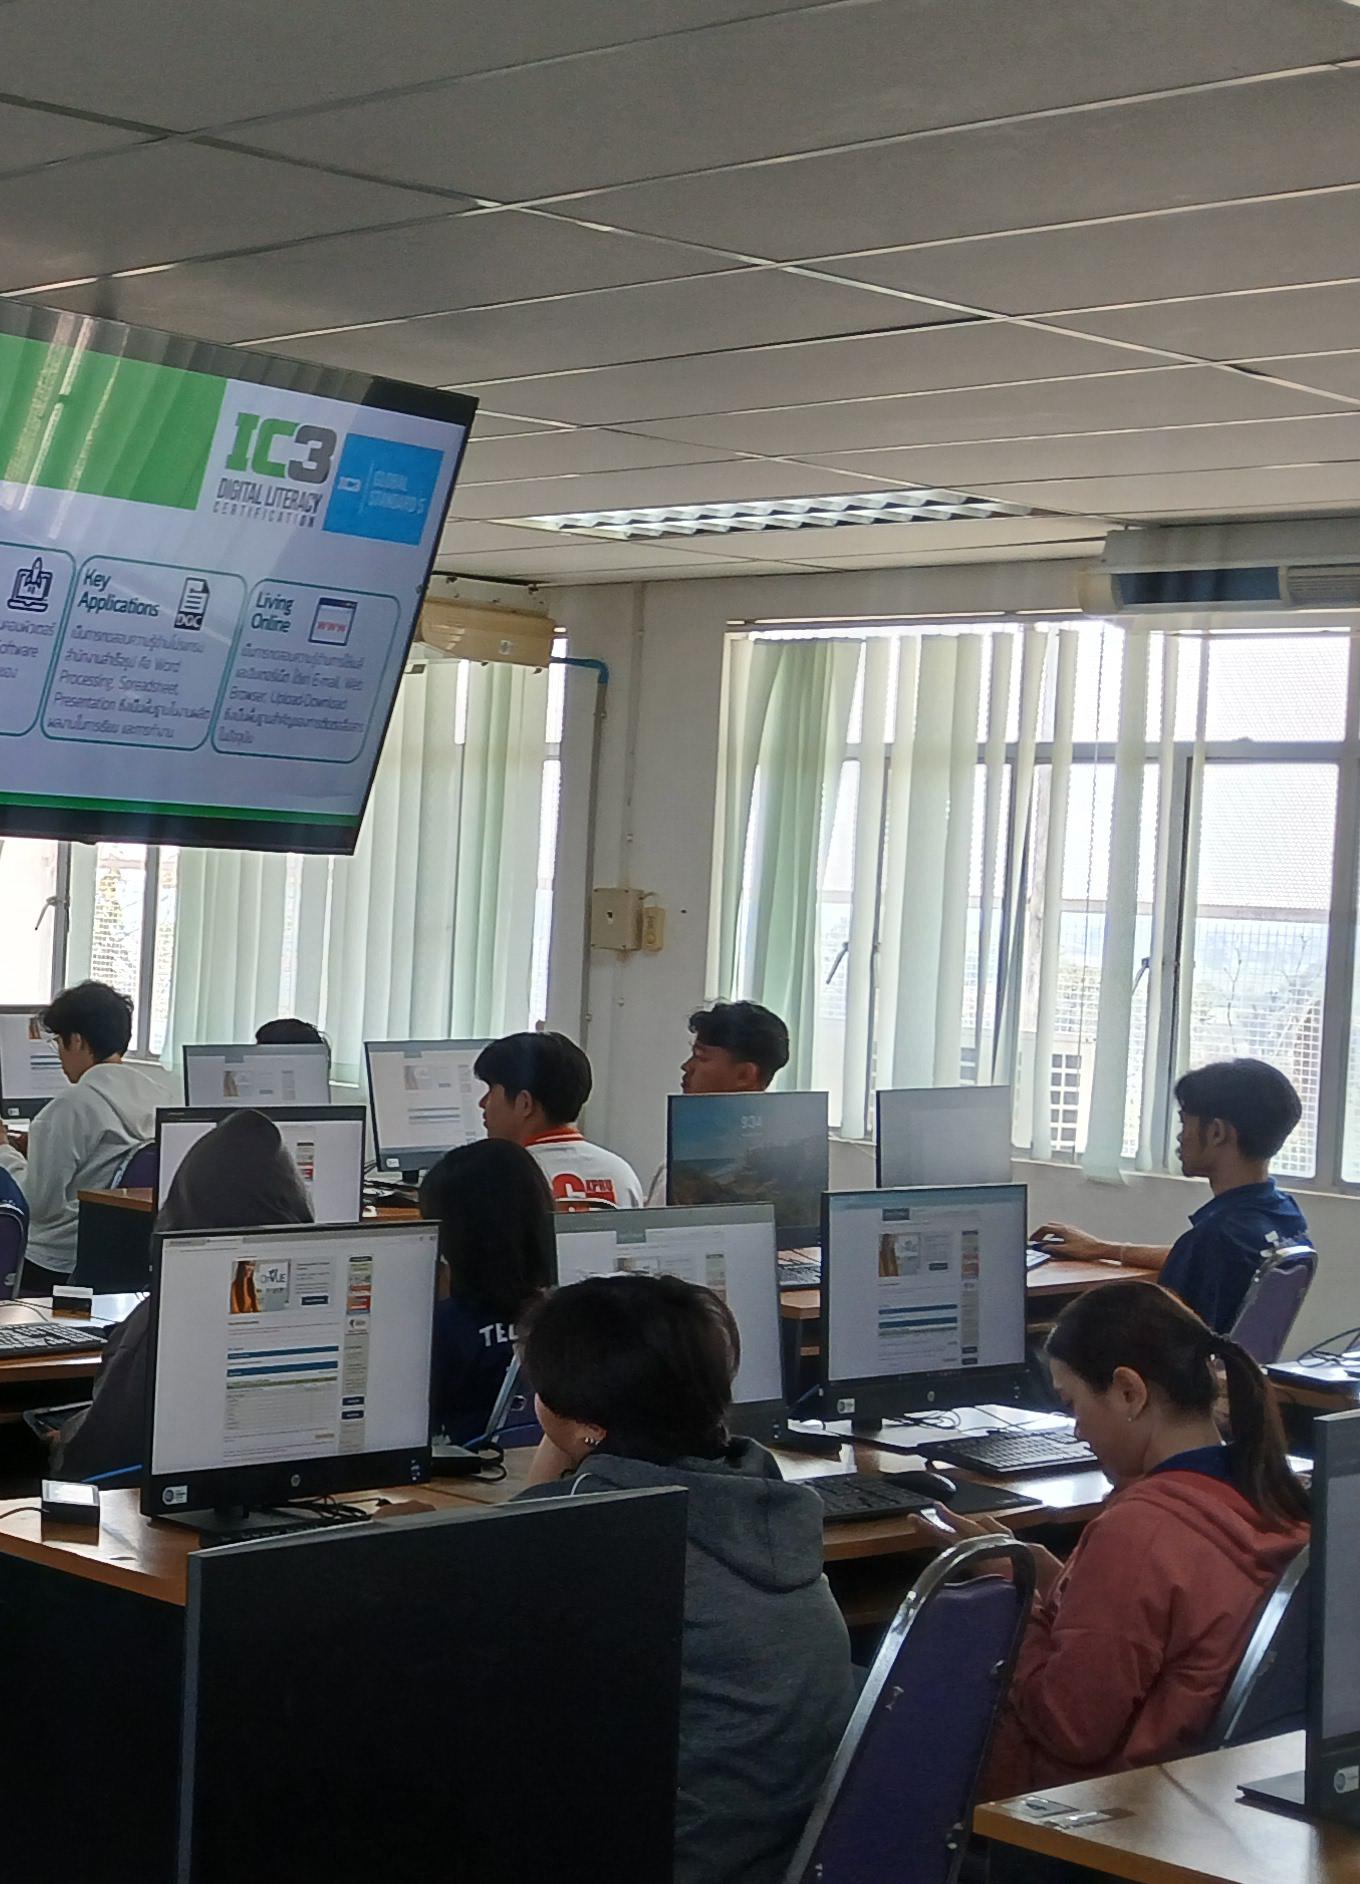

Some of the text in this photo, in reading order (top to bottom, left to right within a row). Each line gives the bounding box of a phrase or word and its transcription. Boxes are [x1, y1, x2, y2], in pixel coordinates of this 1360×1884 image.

[225, 411, 337, 484] IC3
[217, 477, 323, 513] DIGITAL LITERACY
[213, 500, 316, 528] CERTIFICATION
[83, 568, 111, 592] Key
[77, 591, 160, 617] Applications
[256, 592, 295, 616] Living
[176, 613, 202, 629] DOC
[251, 612, 291, 634] Online
